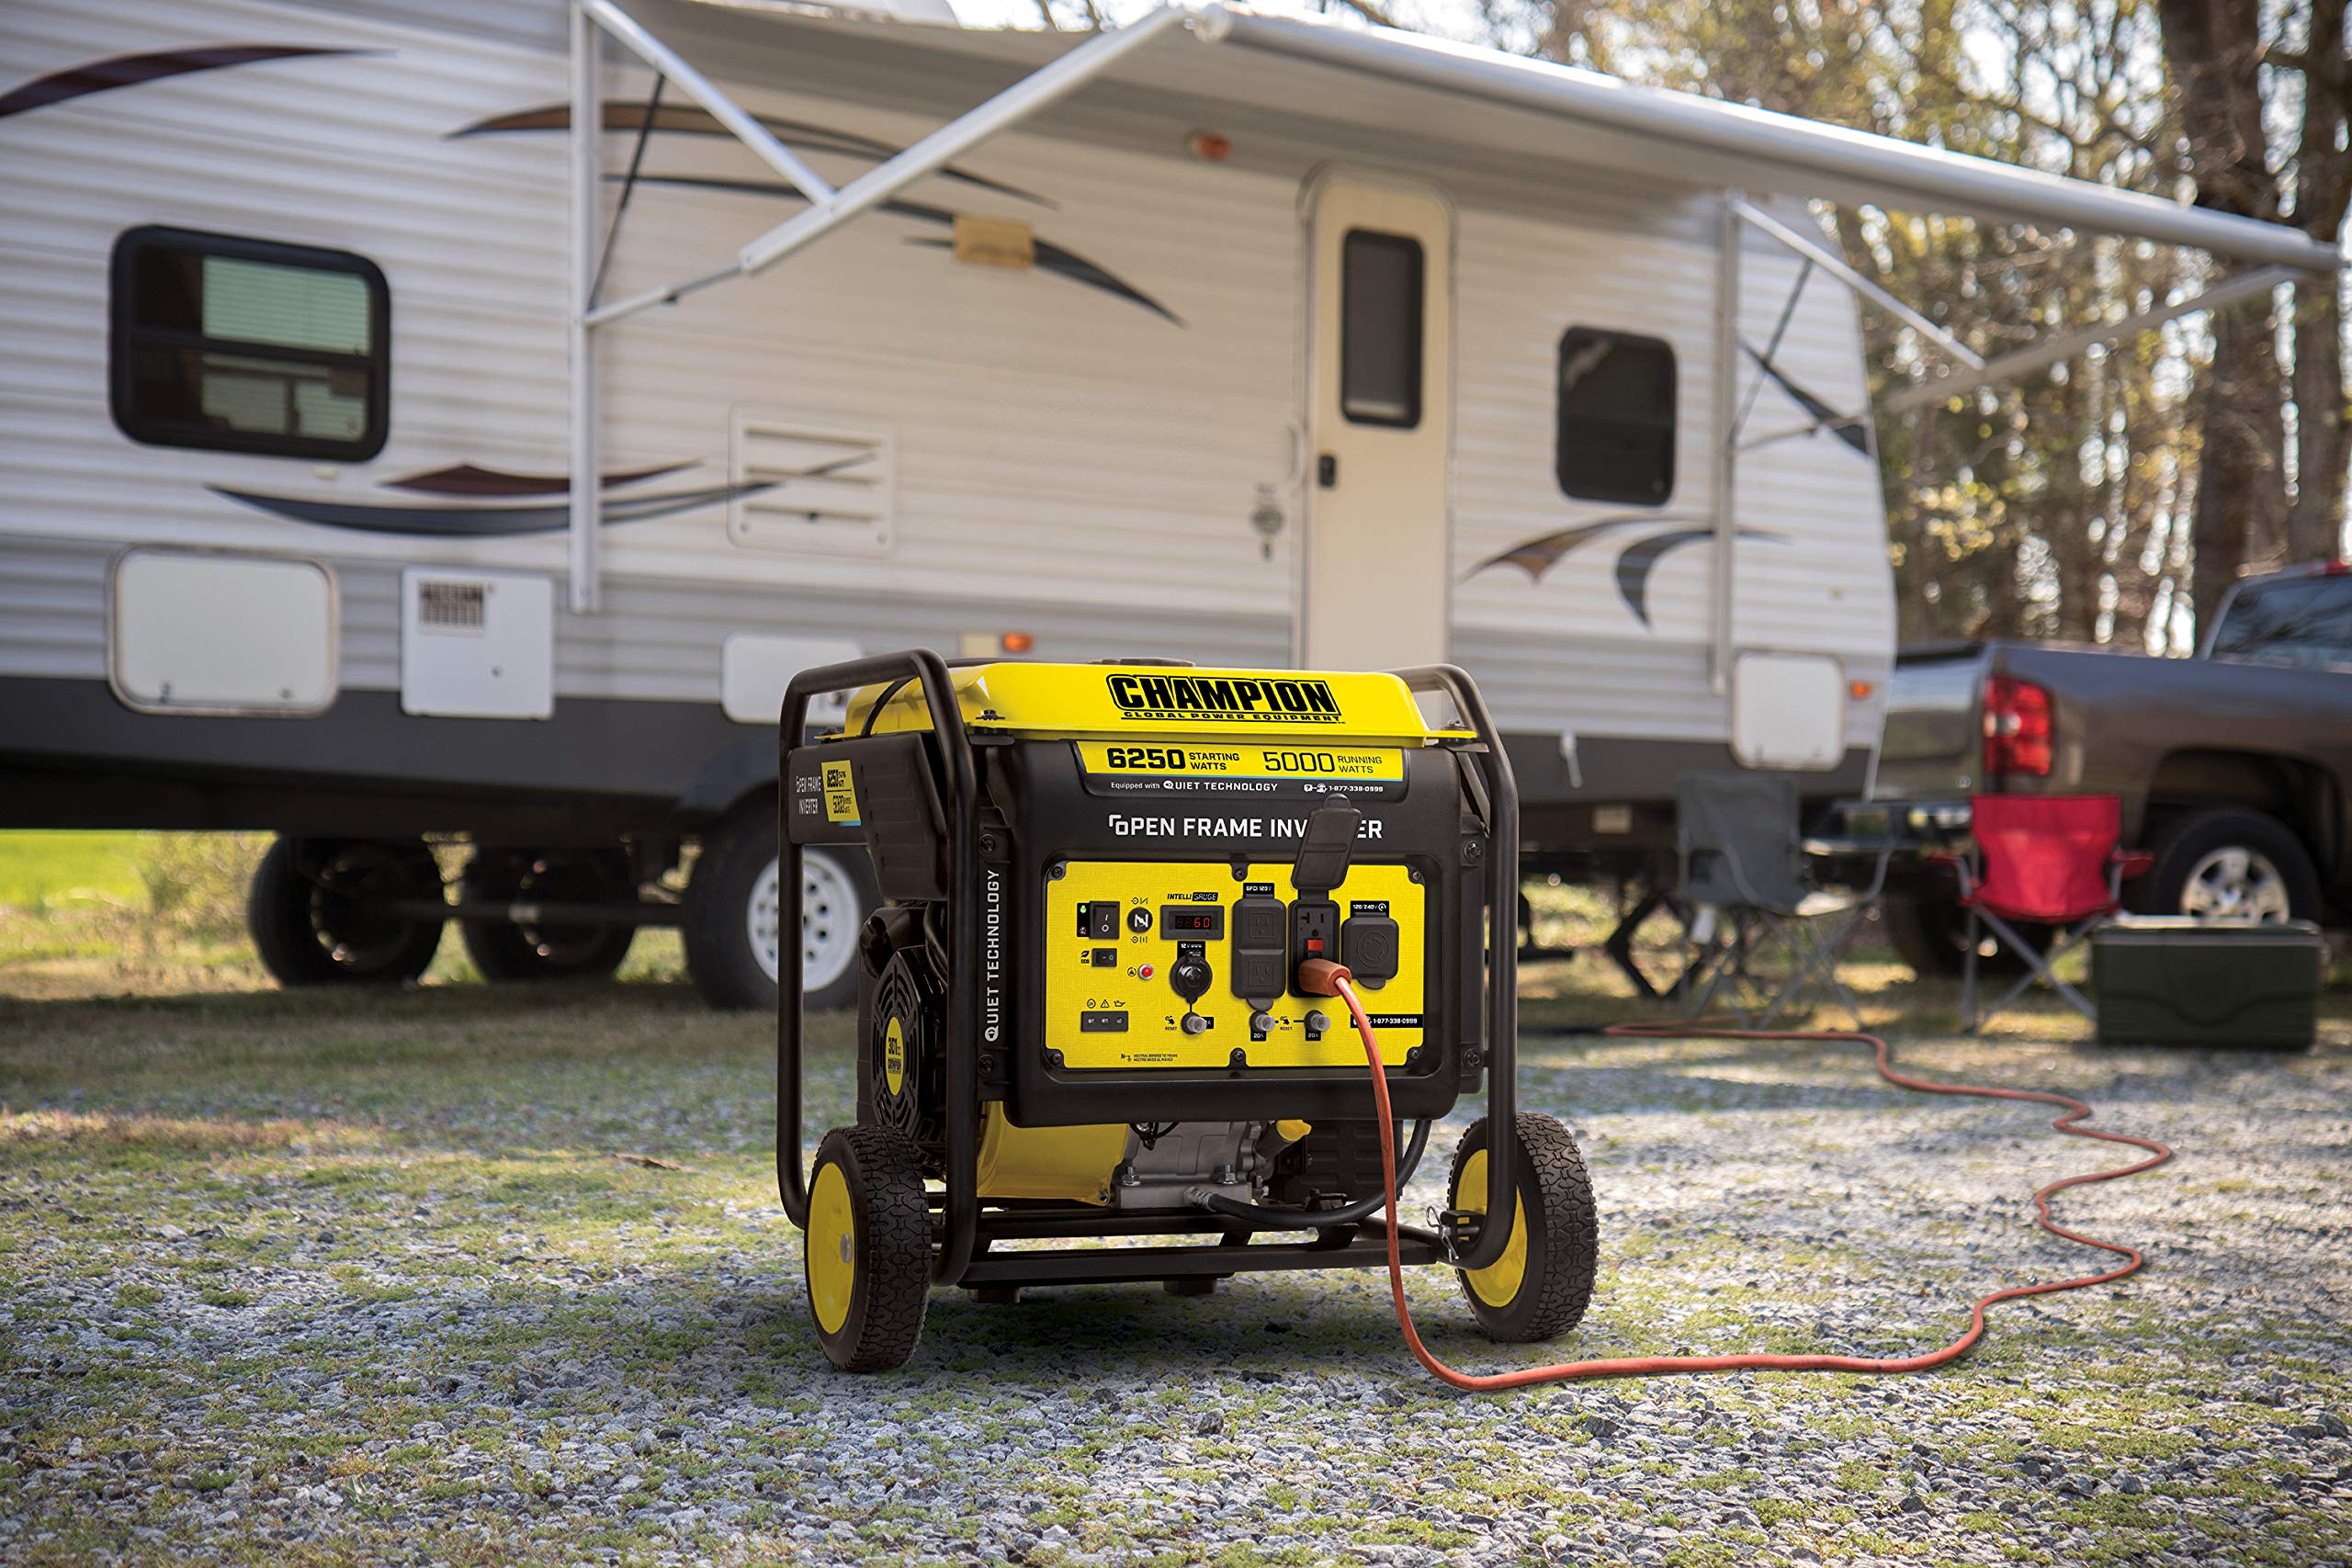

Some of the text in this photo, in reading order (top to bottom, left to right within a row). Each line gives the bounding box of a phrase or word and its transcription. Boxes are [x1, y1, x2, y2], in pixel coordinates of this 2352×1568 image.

[1108, 675, 1340, 714] CHAMPION
[1253, 714, 1340, 722] EQUIPMENT
[1106, 748, 1186, 770] 6250
[1188, 752, 1240, 761] STARTING
[1262, 751, 1335, 773] 5000
[1337, 755, 1383, 764] RUNNING
[1190, 761, 1227, 771] WATTS
[1339, 765, 1374, 773] WATTS
[1111, 782, 1143, 790] Equipped
[1162, 780, 1201, 790] QUIET
[1204, 782, 1278, 792] TECHNOLOGY
[1108, 814, 1383, 839] OPEN FRAME INVER
[1193, 893, 1217, 901] GAUGE
[984, 869, 1000, 1043] QUIET TECHNOLOGY
